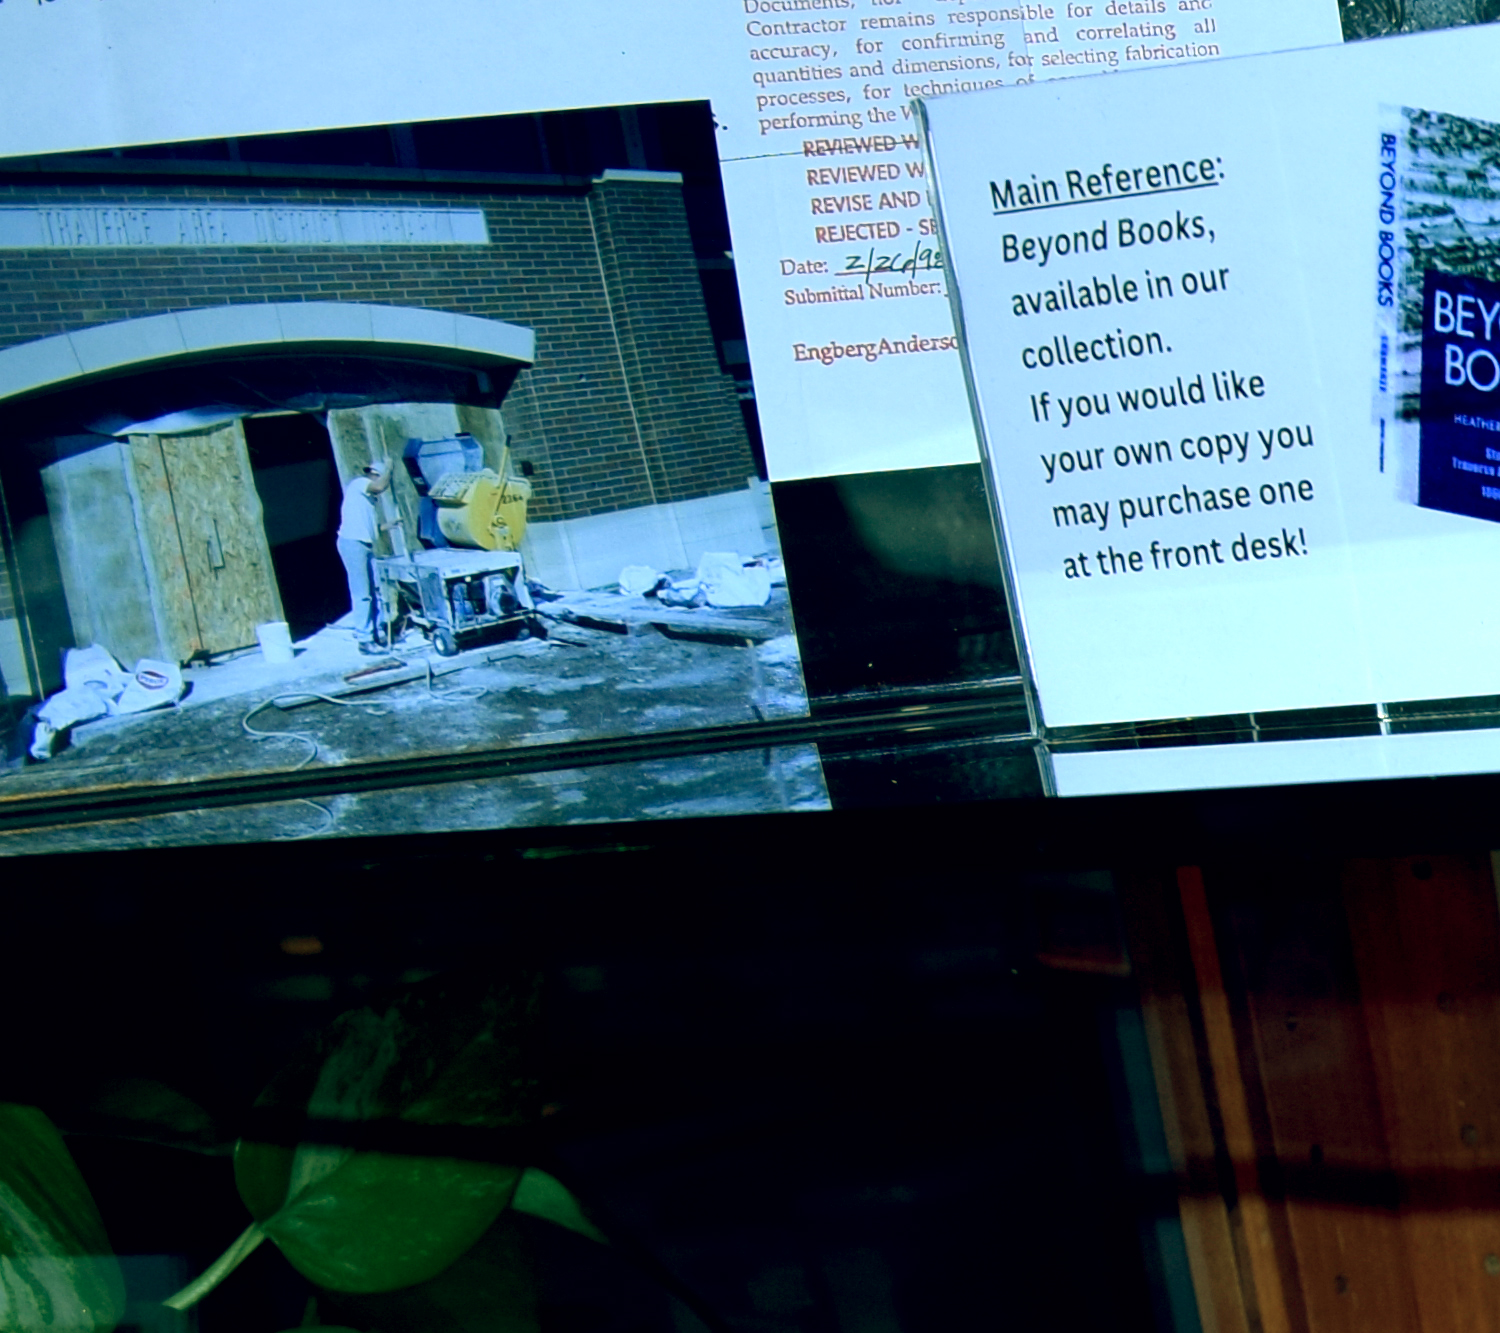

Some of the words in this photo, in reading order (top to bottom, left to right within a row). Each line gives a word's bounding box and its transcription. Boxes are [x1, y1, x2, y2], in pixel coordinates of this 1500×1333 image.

[746, 17, 847, 37] Contractor
[861, 12, 935, 30] remains
[948, 4, 1054, 28] responsible
[1068, 2, 1093, 18] for
[1105, 0, 1166, 16] details
[750, 43, 838, 61] accuracy,
[856, 38, 883, 54] for
[902, 32, 1005, 50] confirming
[1024, 26, 1059, 44] and
[1076, 21, 1176, 41] correlating
[1194, 18, 1216, 34] all
[752, 66, 842, 88] quantities
[850, 60, 884, 77] and
[892, 56, 1000, 75] dimensions,
[1008, 51, 1034, 67] for
[1041, 47, 1119, 67] selecting
[1126, 43, 1220, 62] fabrication
[757, 92, 851, 112] processes,
[863, 84, 891, 100] for
[759, 111, 863, 135] performing
[868, 107, 896, 123] the
[803, 135, 895, 157] REVIEWED
[806, 163, 901, 186] REVIEWED
[990, 173, 1060, 210] Main
[1065, 157, 1225, 200] Reference:
[1380, 133, 1396, 226] BEYOND
[811, 194, 873, 215] REVISE
[878, 190, 921, 211] AND
[815, 221, 901, 244] REJECTED
[1002, 220, 1108, 267] Beyond
[1118, 210, 1216, 247] Books,
[780, 258, 829, 276] Date:
[1377, 230, 1395, 308] BOOKS
[784, 284, 865, 305] Submittal
[869, 281, 942, 300] Number:
[1011, 273, 1138, 316] available
[1145, 269, 1173, 299] in
[1181, 267, 1229, 295] our
[1021, 328, 1172, 369] collection.
[1030, 391, 1050, 422] If
[1058, 393, 1111, 427] you
[1117, 374, 1206, 412] would
[1212, 370, 1265, 401] like
[1040, 448, 1104, 484] your
[1113, 439, 1172, 467] own
[1180, 431, 1249, 464] copy
[1258, 425, 1314, 460] you
[1052, 500, 1110, 531] may
[1119, 484, 1251, 528] purchase
[1259, 478, 1314, 505] one
[1064, 552, 1092, 579] at
[1096, 546, 1144, 576] the
[1149, 539, 1225, 570] front
[1231, 528, 1309, 561] desk!
